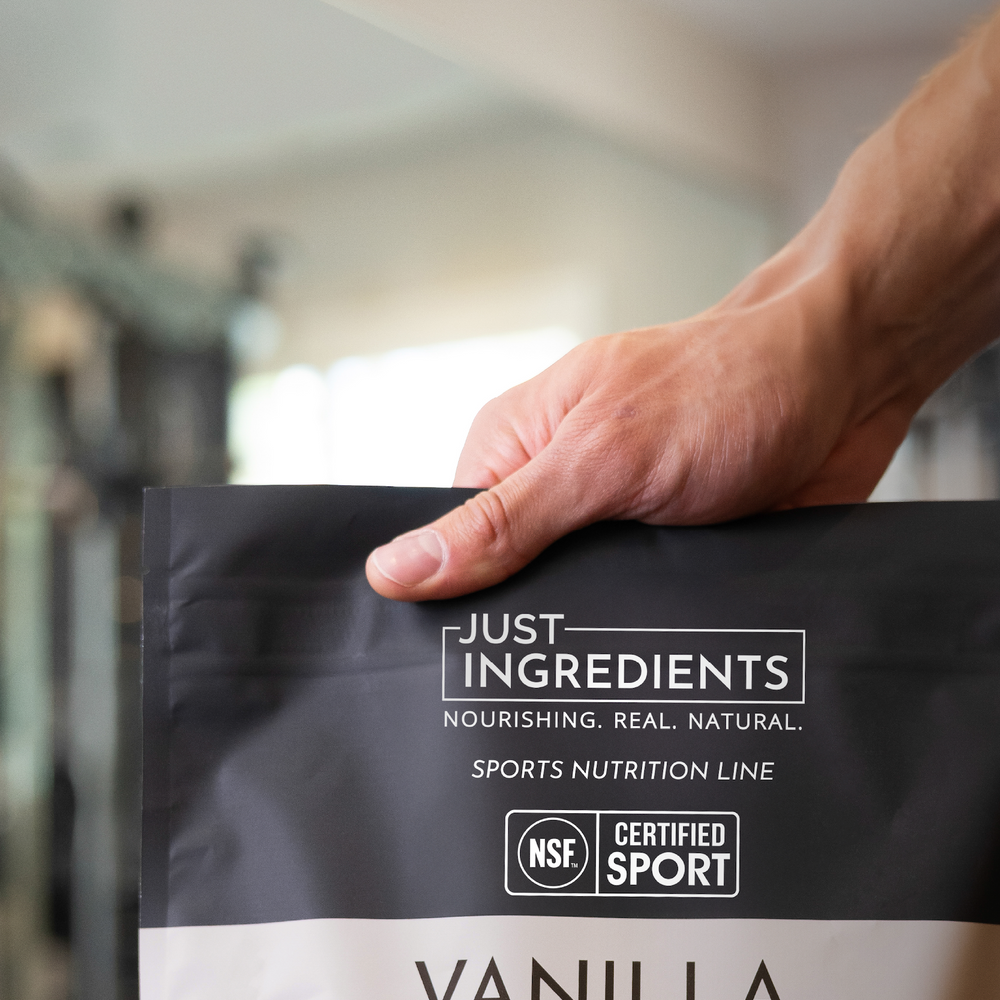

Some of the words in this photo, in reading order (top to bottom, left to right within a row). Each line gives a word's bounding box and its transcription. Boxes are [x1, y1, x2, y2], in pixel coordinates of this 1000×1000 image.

[459, 613, 565, 645] JUST
[464, 652, 789, 691] INGREDIENTS
[443, 711, 602, 729] NOURISHING.
[614, 712, 677, 730] REAL.
[689, 713, 803, 731] NATURAL.
[471, 760, 564, 779] SPORTS
[571, 761, 709, 780] NUTRITION
[717, 762, 775, 781] LINE
[614, 821, 726, 847] CERTIFIED
[606, 852, 731, 887] SPORT
